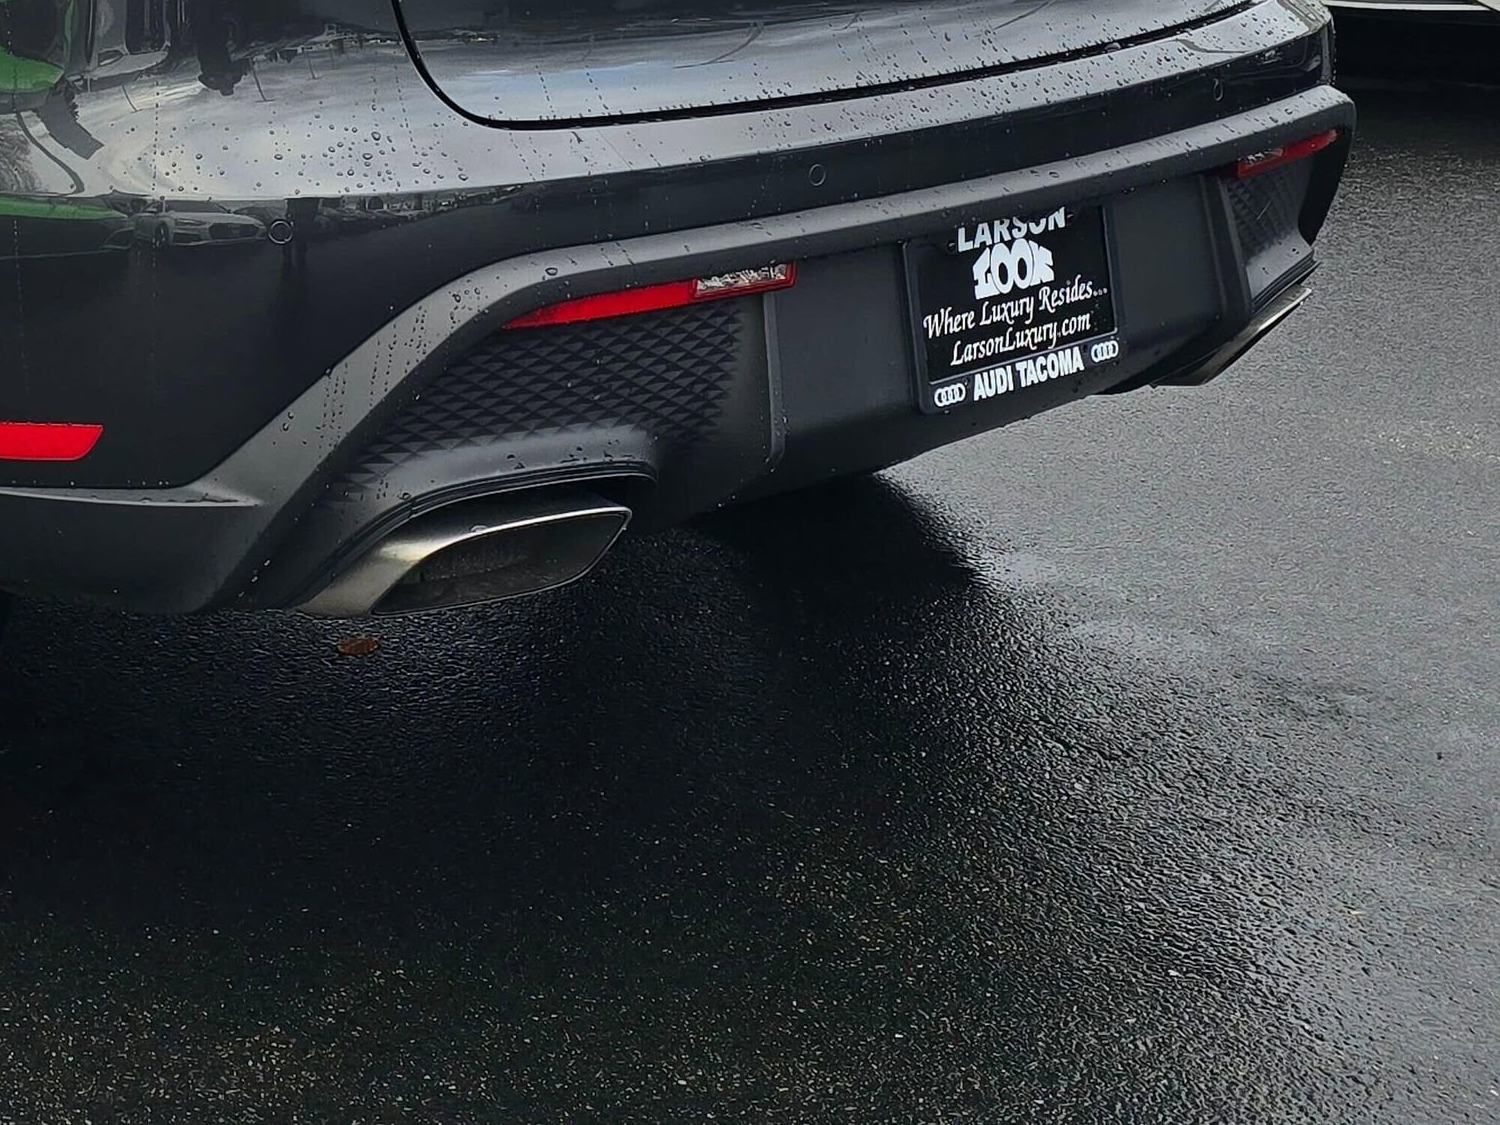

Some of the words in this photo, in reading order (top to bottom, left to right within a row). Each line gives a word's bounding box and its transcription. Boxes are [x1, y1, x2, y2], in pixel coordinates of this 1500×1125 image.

[923, 306, 976, 339] Where
[979, 295, 1035, 325] Luxury
[1038, 274, 1108, 313] Resides...
[950, 313, 1092, 366] LarsonLuxury.com
[973, 371, 1014, 402] AUDI
[1016, 346, 1085, 387] TACOMA
